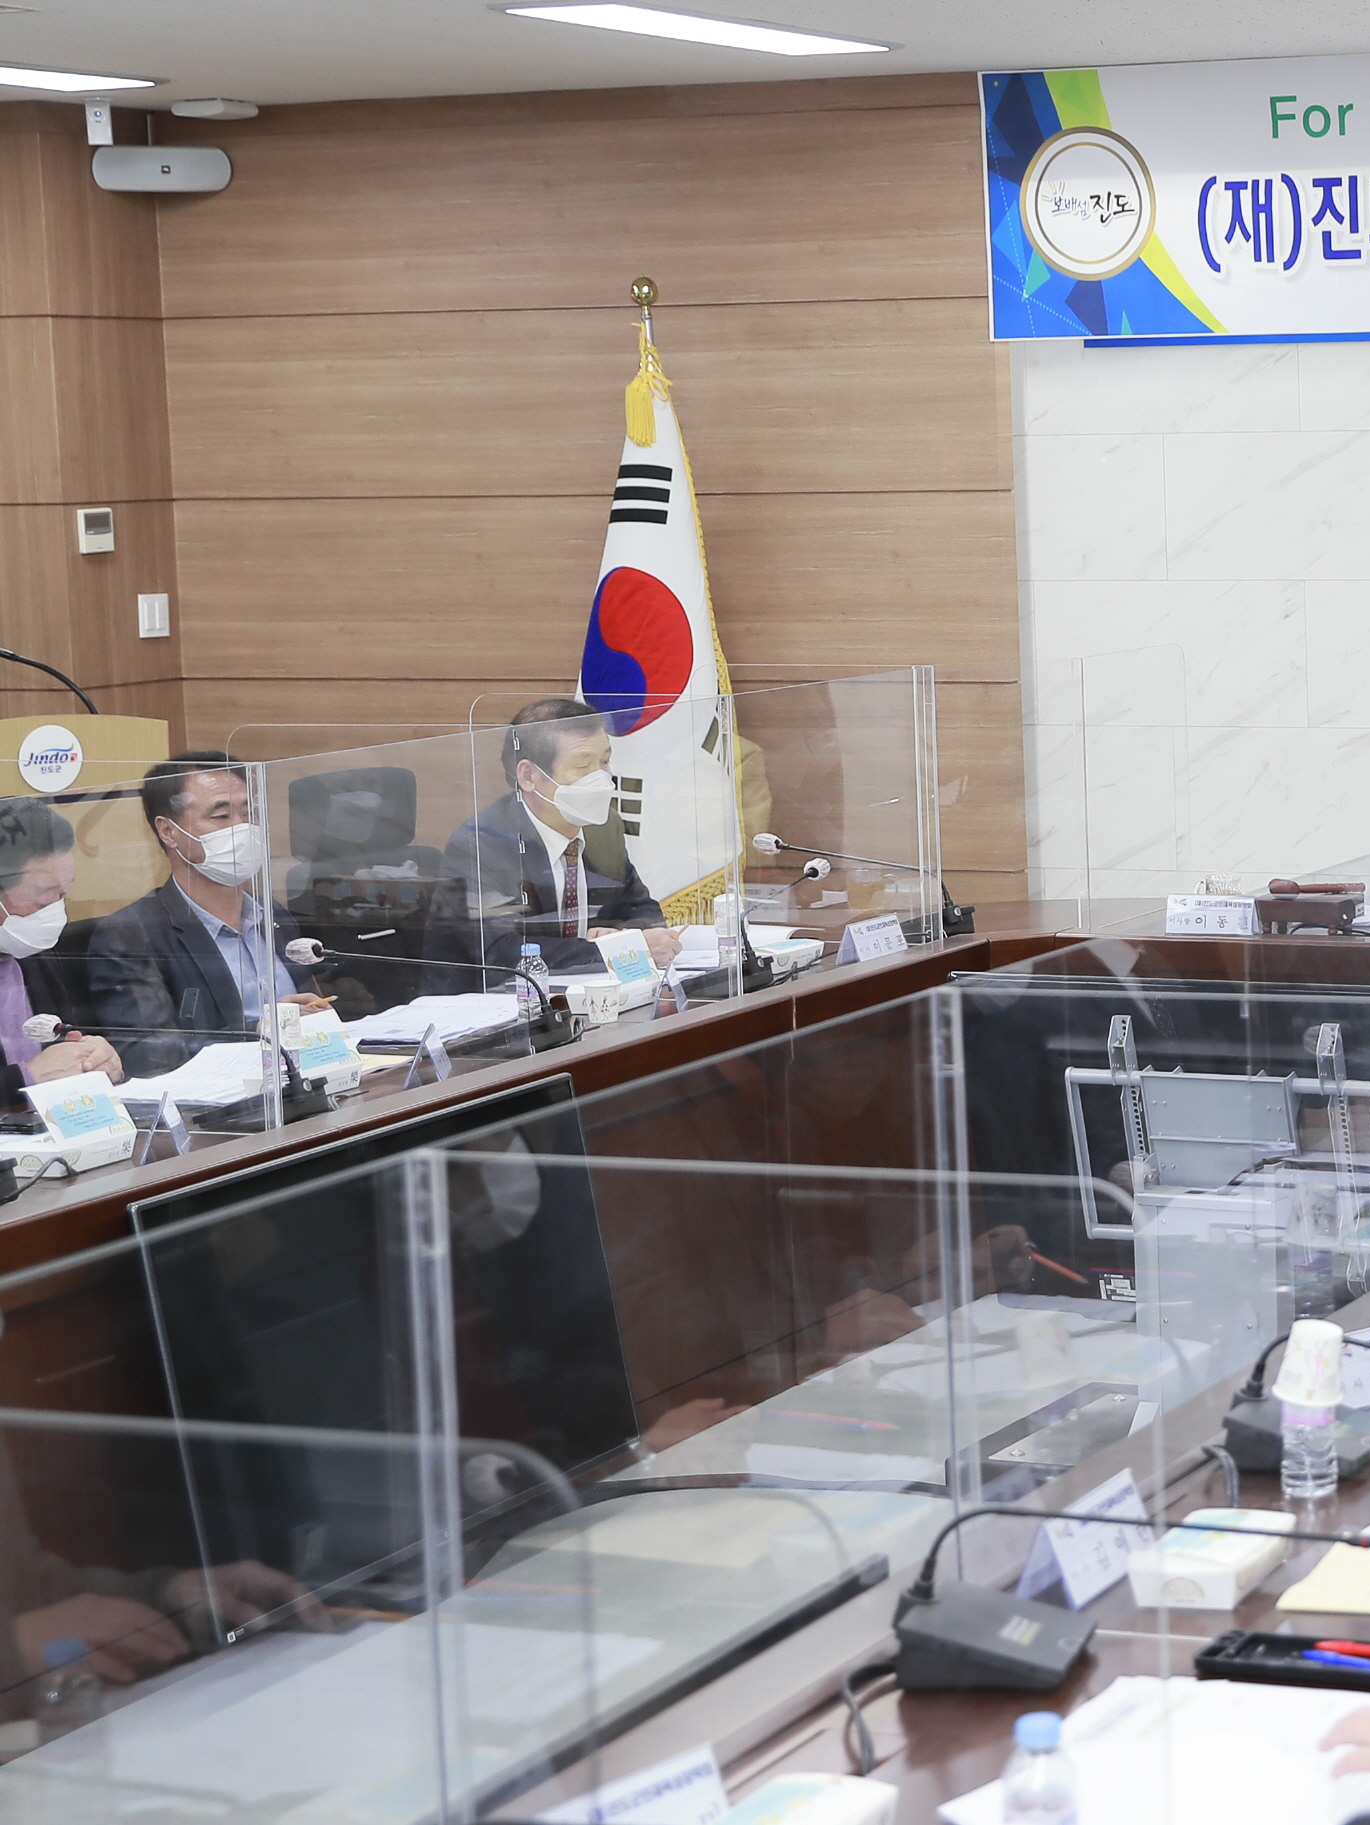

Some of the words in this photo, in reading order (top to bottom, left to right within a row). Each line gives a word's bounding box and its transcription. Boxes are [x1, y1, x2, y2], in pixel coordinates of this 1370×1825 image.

[1271, 95, 1353, 138] For
[1089, 191, 1135, 224] 진도
[23, 751, 69, 767] Jindo
